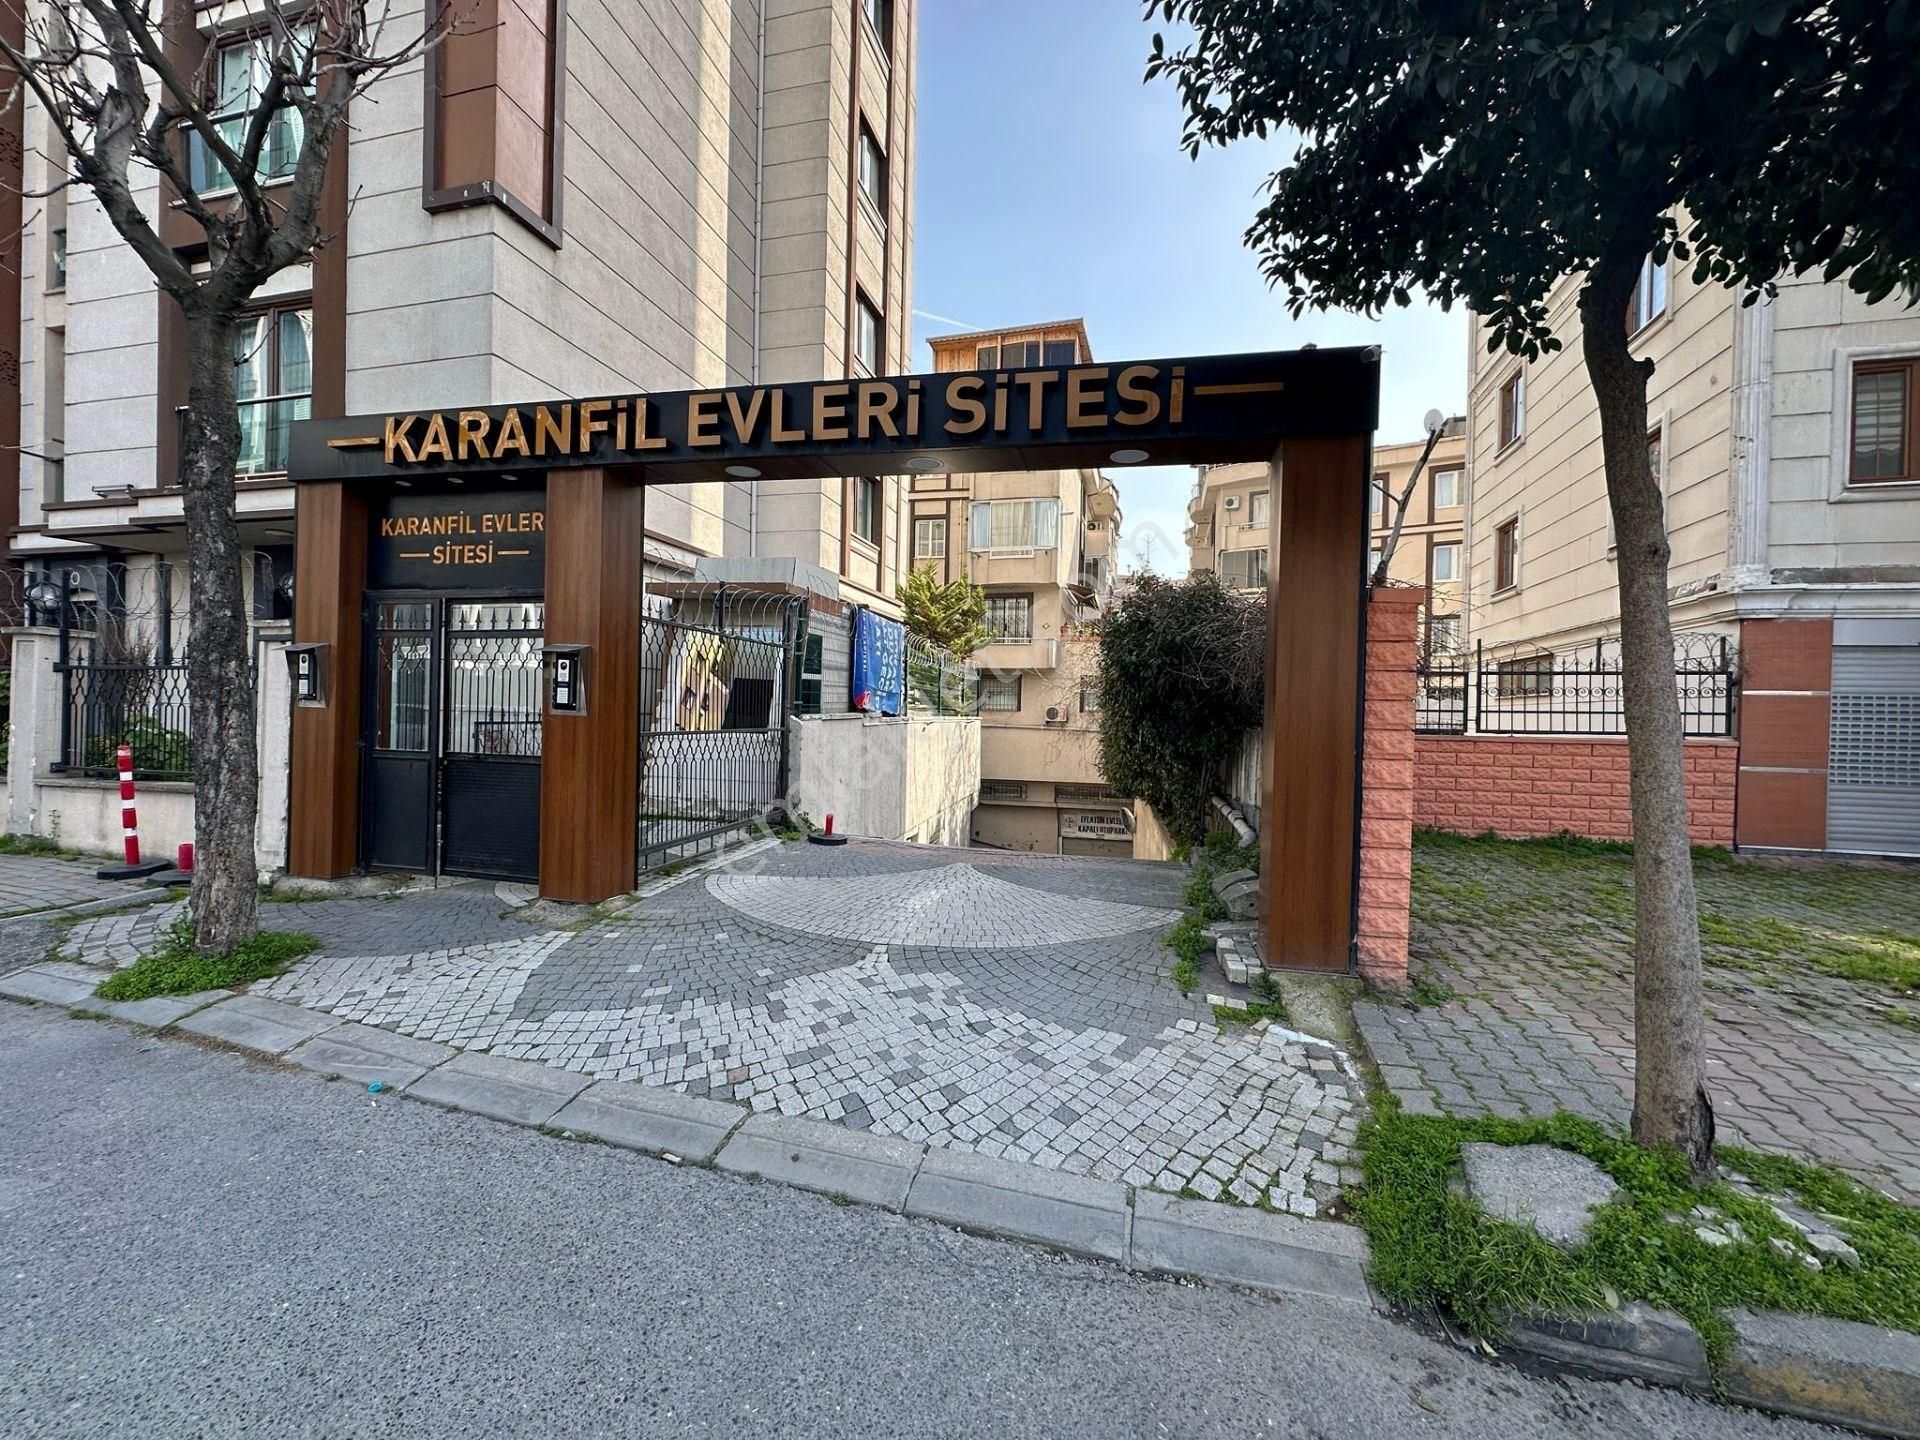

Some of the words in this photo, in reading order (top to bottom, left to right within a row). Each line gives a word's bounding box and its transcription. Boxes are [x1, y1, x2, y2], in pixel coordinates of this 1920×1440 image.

[381, 510, 476, 537] KARANFİL
[482, 511, 545, 534] EVLER
[432, 540, 494, 565] SİTESİ
